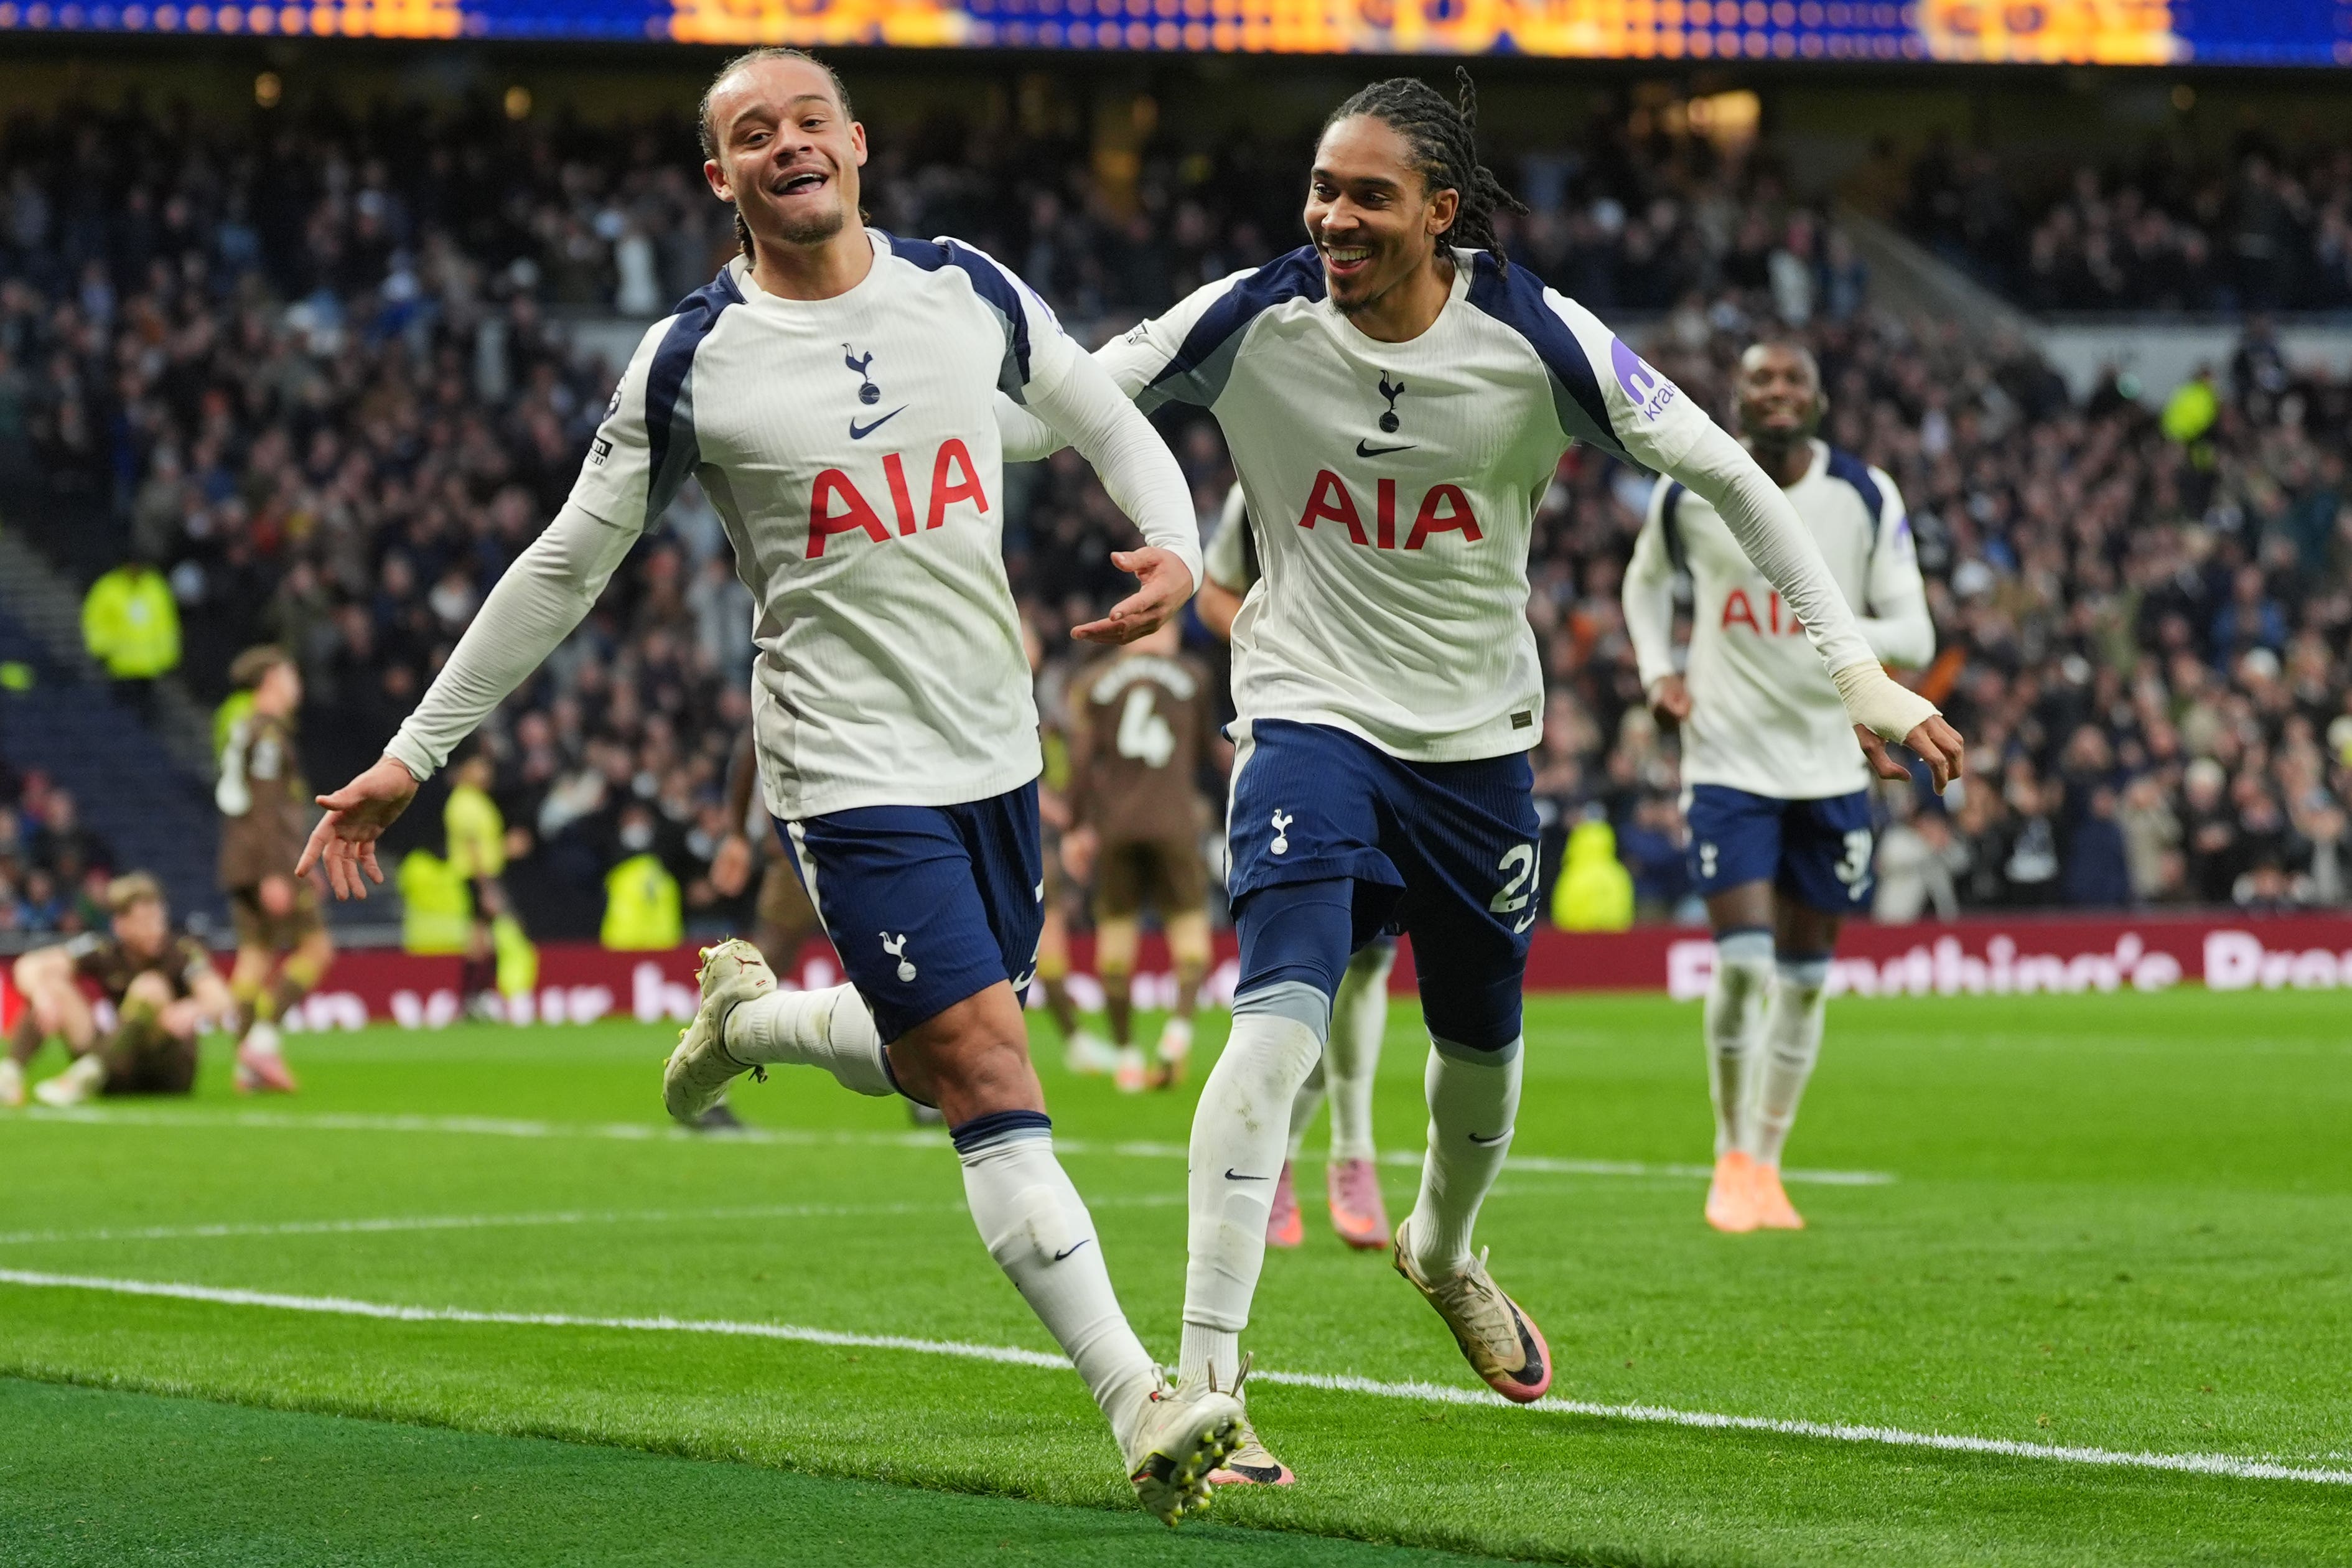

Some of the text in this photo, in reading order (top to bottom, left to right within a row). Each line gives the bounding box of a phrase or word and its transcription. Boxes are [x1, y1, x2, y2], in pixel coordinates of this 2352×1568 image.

[806, 438, 989, 559] AIA
[1298, 469, 1484, 550] AIA
[1118, 686, 1176, 768] 4
[1489, 839, 1541, 912] 2
